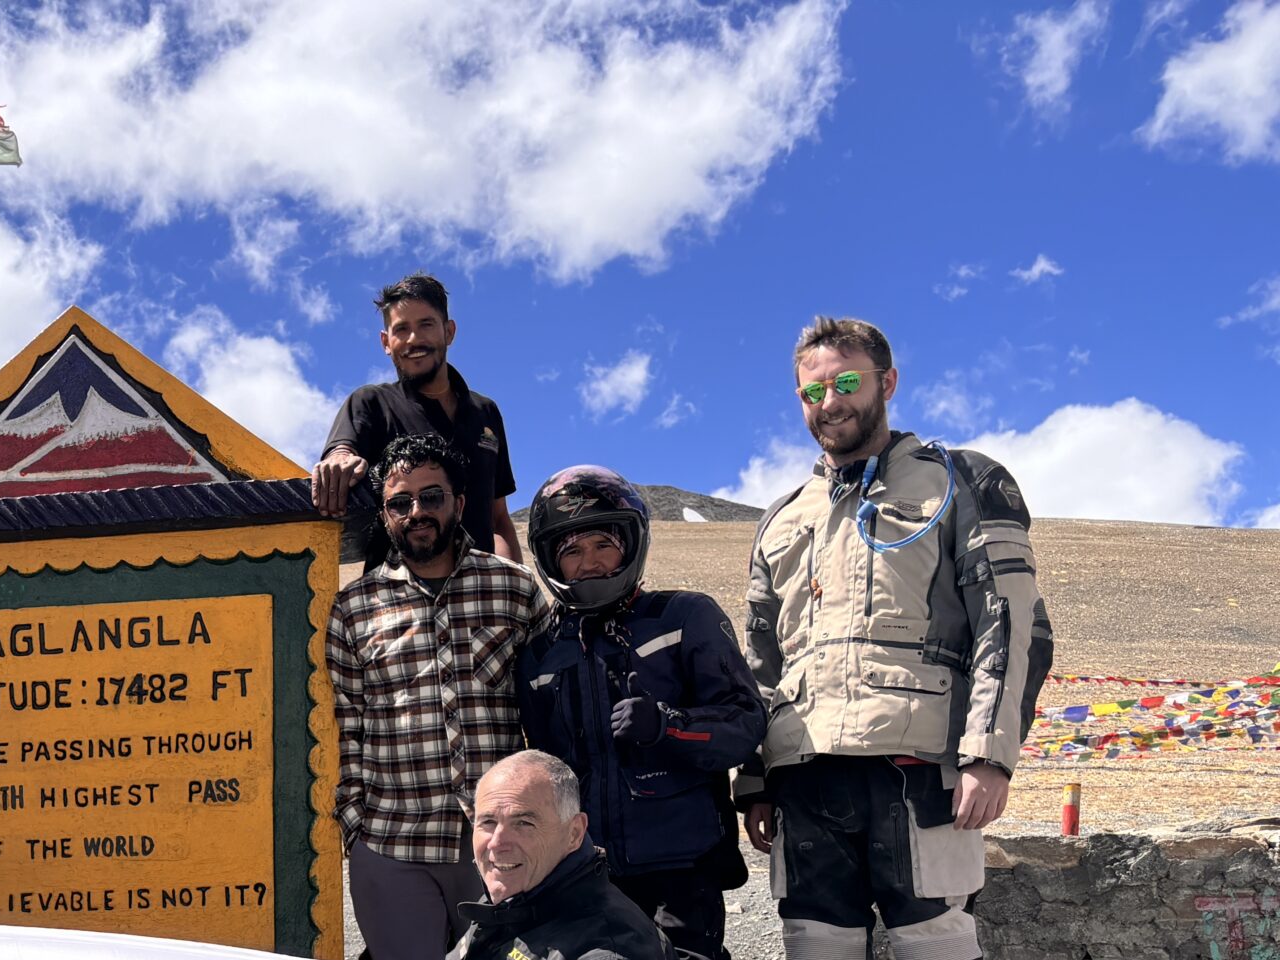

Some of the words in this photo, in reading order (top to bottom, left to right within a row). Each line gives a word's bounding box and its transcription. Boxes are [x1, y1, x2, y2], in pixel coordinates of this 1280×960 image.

[211, 668, 253, 701] FT
[21, 737, 132, 763] PASSING
[143, 730, 253, 756] THROUGH
[40, 783, 160, 809] HIGHEST
[188, 778, 241, 804] PASS
[25, 838, 73, 860] THE
[83, 835, 155, 858] WORLD
[127, 888, 151, 909] IS
[162, 886, 211, 909] NOT
[224, 882, 267, 907] IT?
